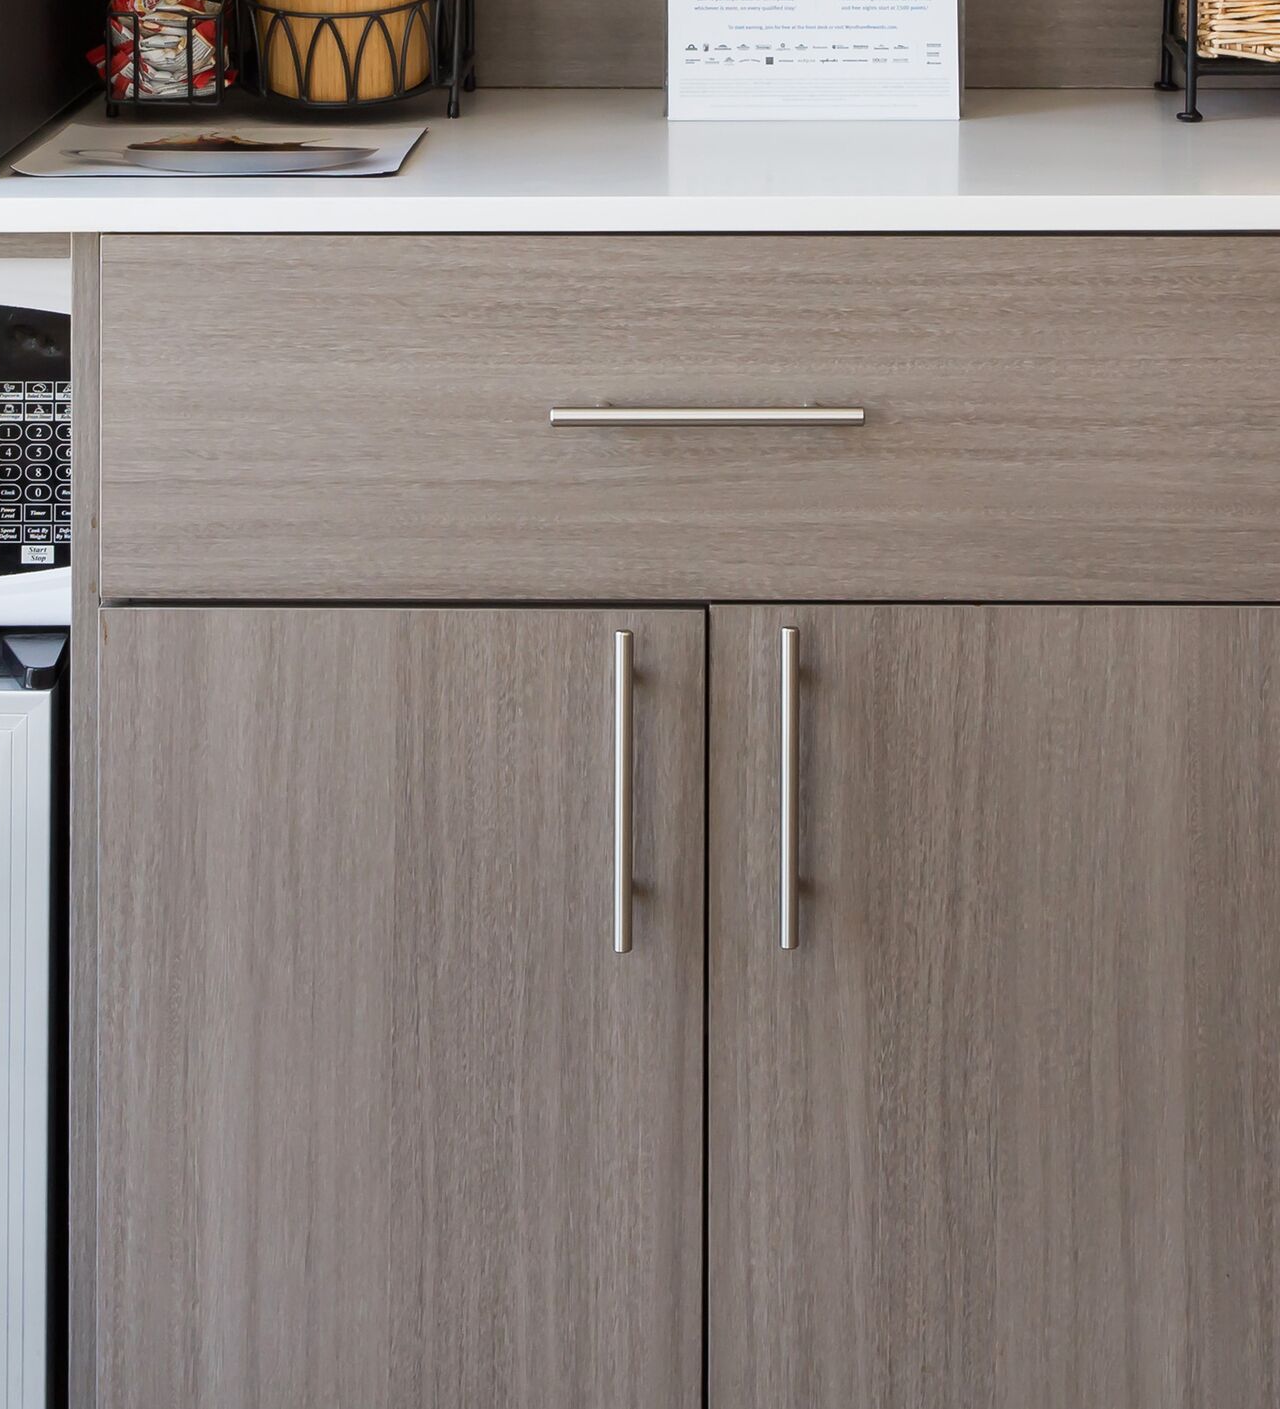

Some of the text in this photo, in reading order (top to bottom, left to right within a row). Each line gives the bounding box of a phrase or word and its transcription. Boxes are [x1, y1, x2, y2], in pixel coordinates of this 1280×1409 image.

[6, 428, 10, 437] 1
[36, 428, 42, 437] 2
[66, 428, 71, 437] 3
[5, 448, 12, 457] 4
[36, 448, 42, 457] 5
[65, 448, 71, 457] 6
[5, 468, 11, 477] 7
[35, 468, 42, 477] 8
[65, 468, 71, 477] 9
[35, 488, 41, 497] 0
